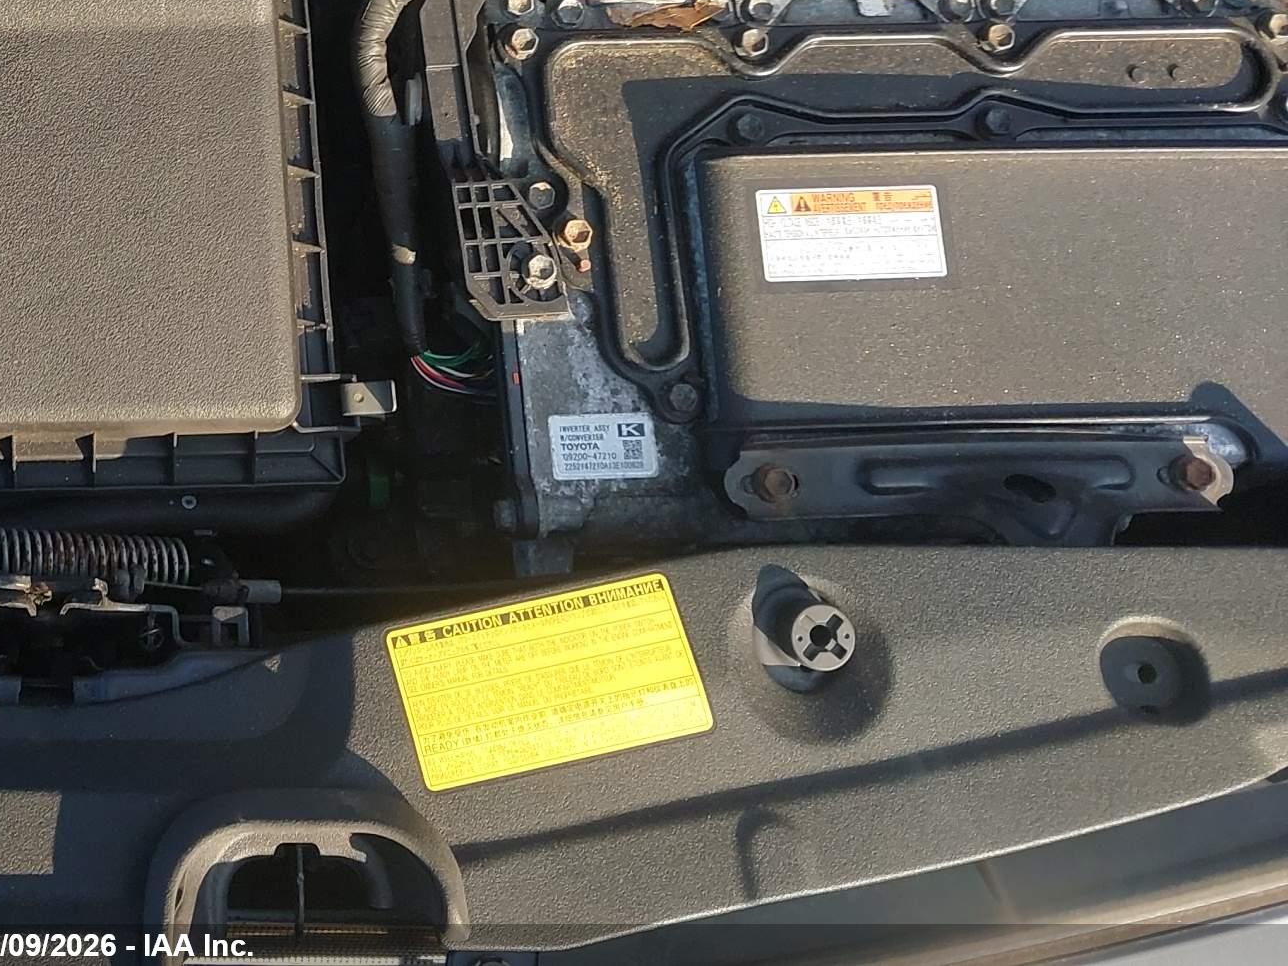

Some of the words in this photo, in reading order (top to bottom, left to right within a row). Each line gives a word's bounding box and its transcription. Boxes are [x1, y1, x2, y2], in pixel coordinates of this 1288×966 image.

[811, 193, 856, 203] WARNING
[559, 425, 591, 433] INVERTER
[594, 424, 610, 433] ASSY
[560, 442, 600, 451] TOYOTA
[442, 615, 503, 637] CAUTION
[509, 596, 584, 622] ATTENTION
[589, 579, 662, 605] ВНИМАНИЕ
